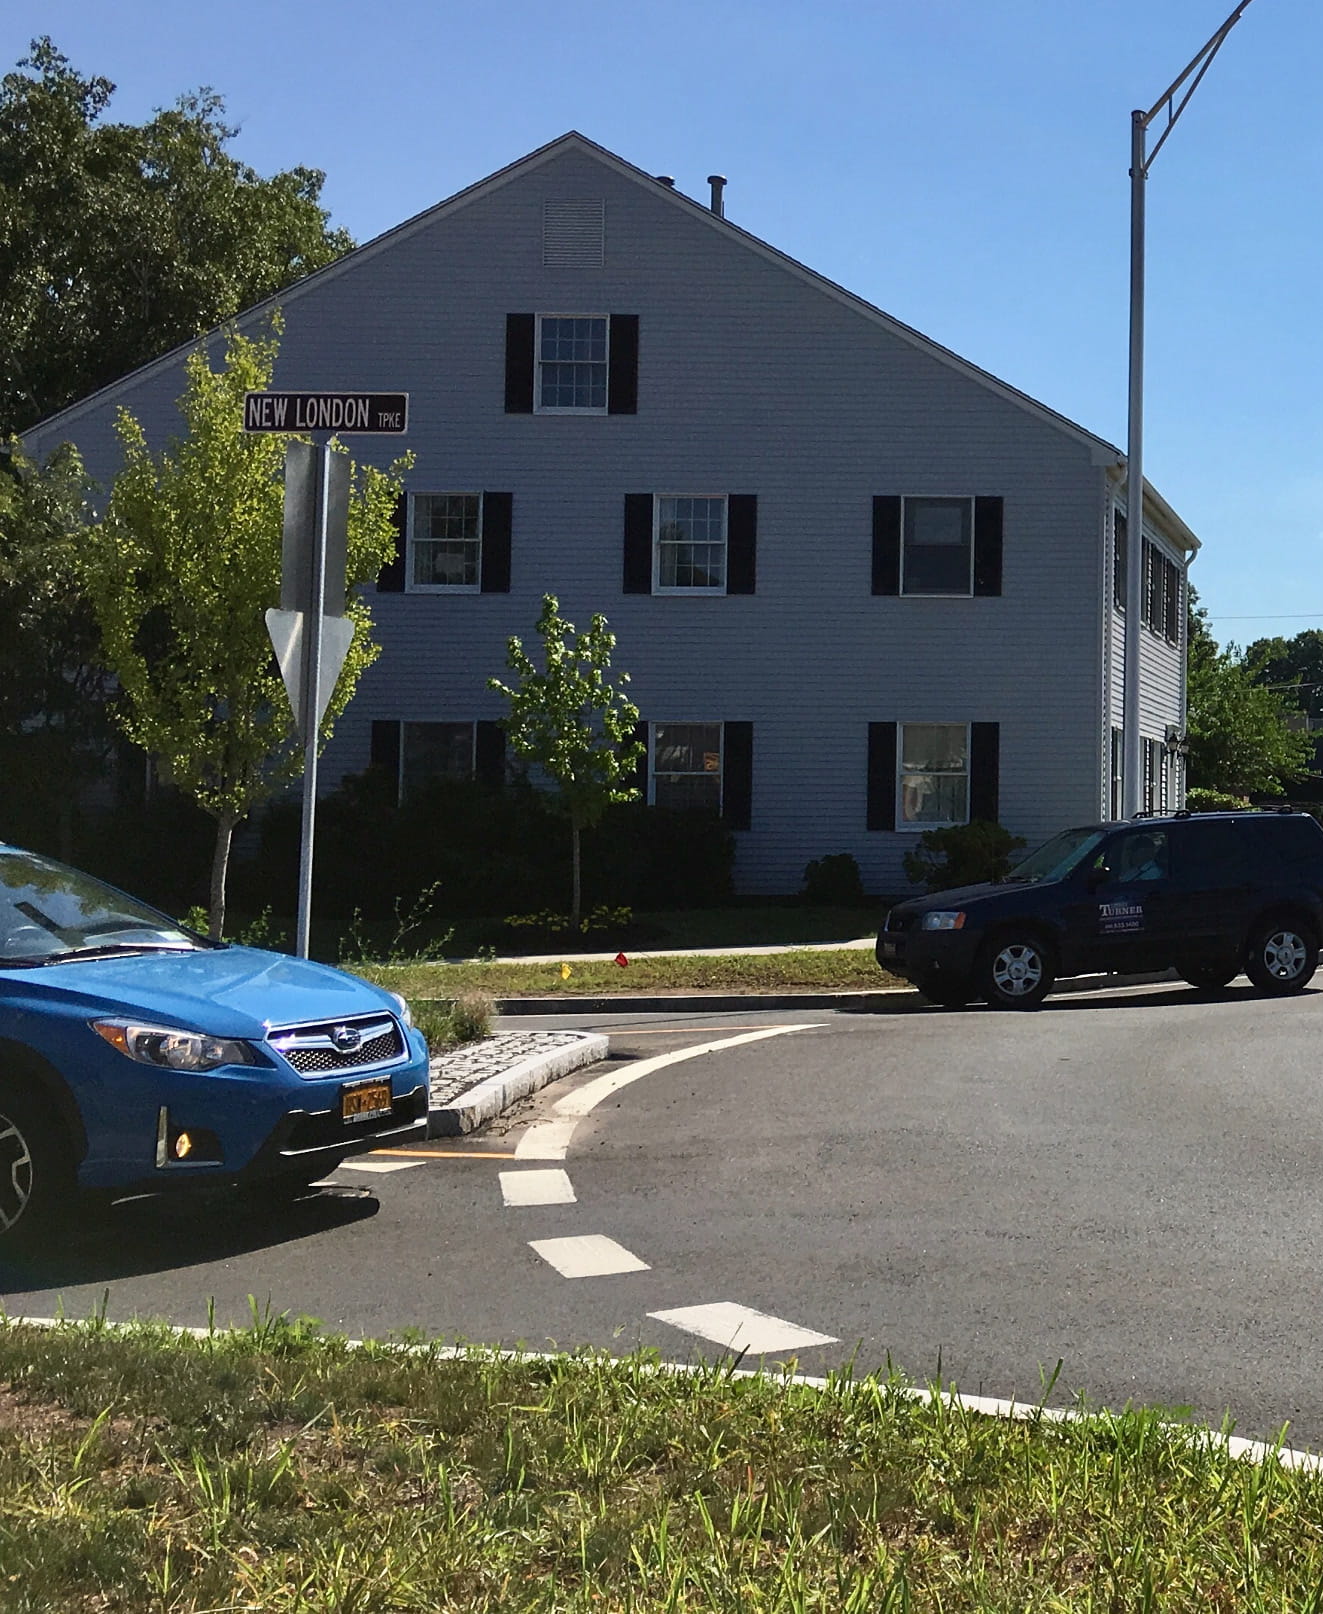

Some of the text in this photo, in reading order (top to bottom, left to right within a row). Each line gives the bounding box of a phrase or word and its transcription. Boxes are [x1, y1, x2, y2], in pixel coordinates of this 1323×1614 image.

[249, 398, 401, 428] NEW LONDON TPKE
[1099, 904, 1144, 917] TURNER
